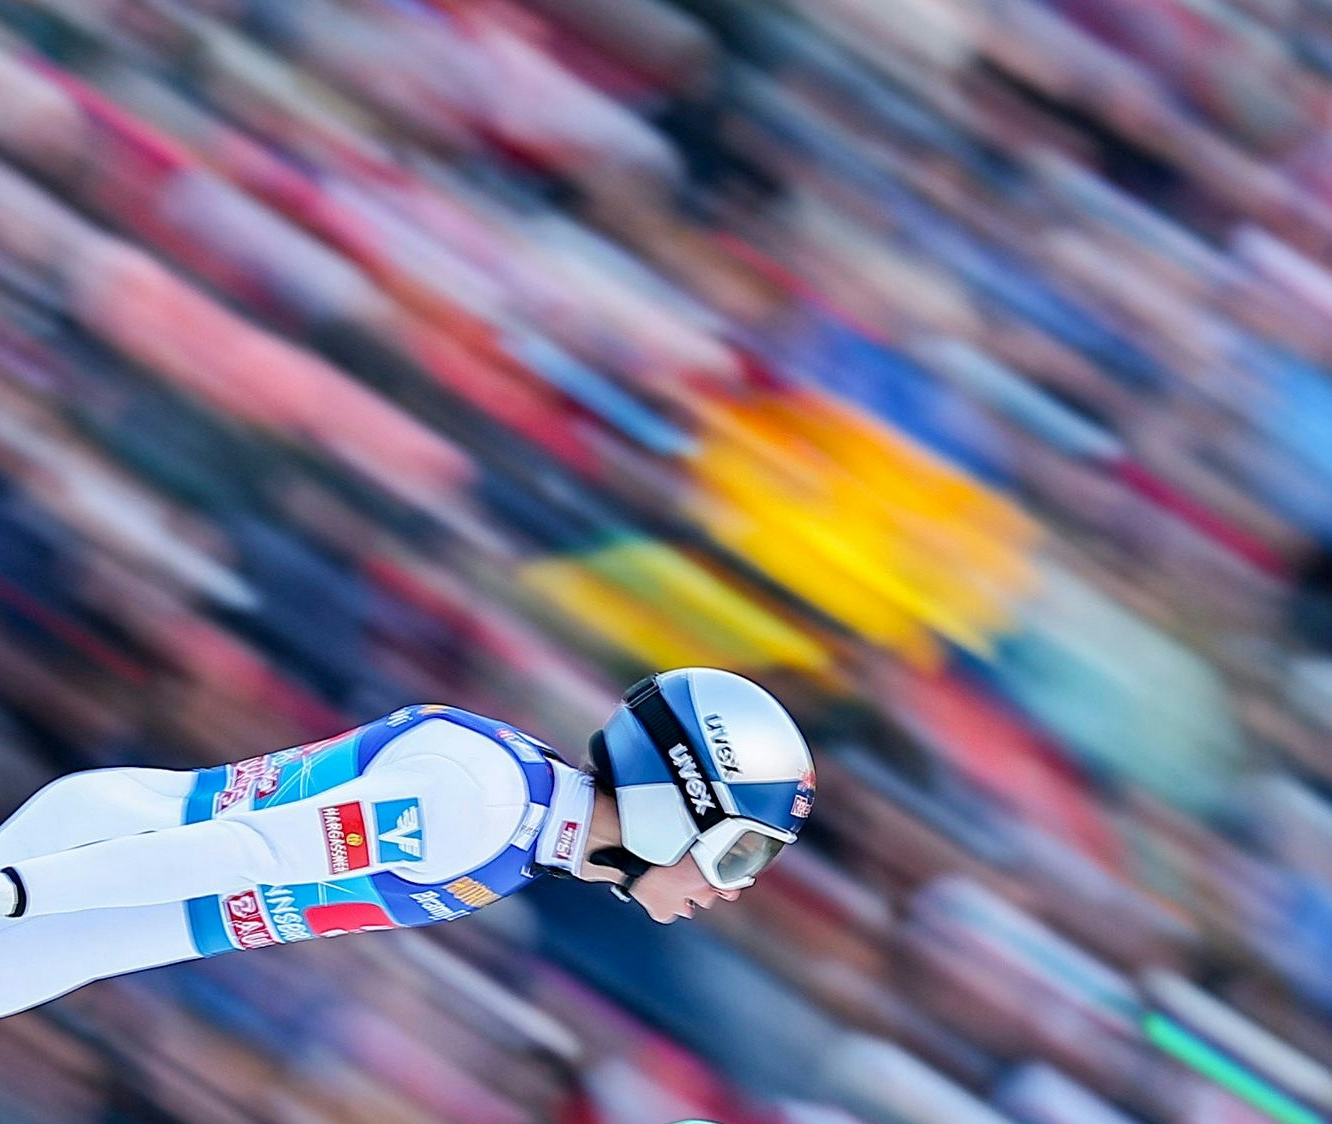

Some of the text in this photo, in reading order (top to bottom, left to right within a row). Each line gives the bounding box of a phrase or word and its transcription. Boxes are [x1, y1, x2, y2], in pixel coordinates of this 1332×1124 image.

[668, 742, 718, 817] uvex
[703, 713, 744, 780] uvex
[322, 806, 349, 874] HARGASSNER
